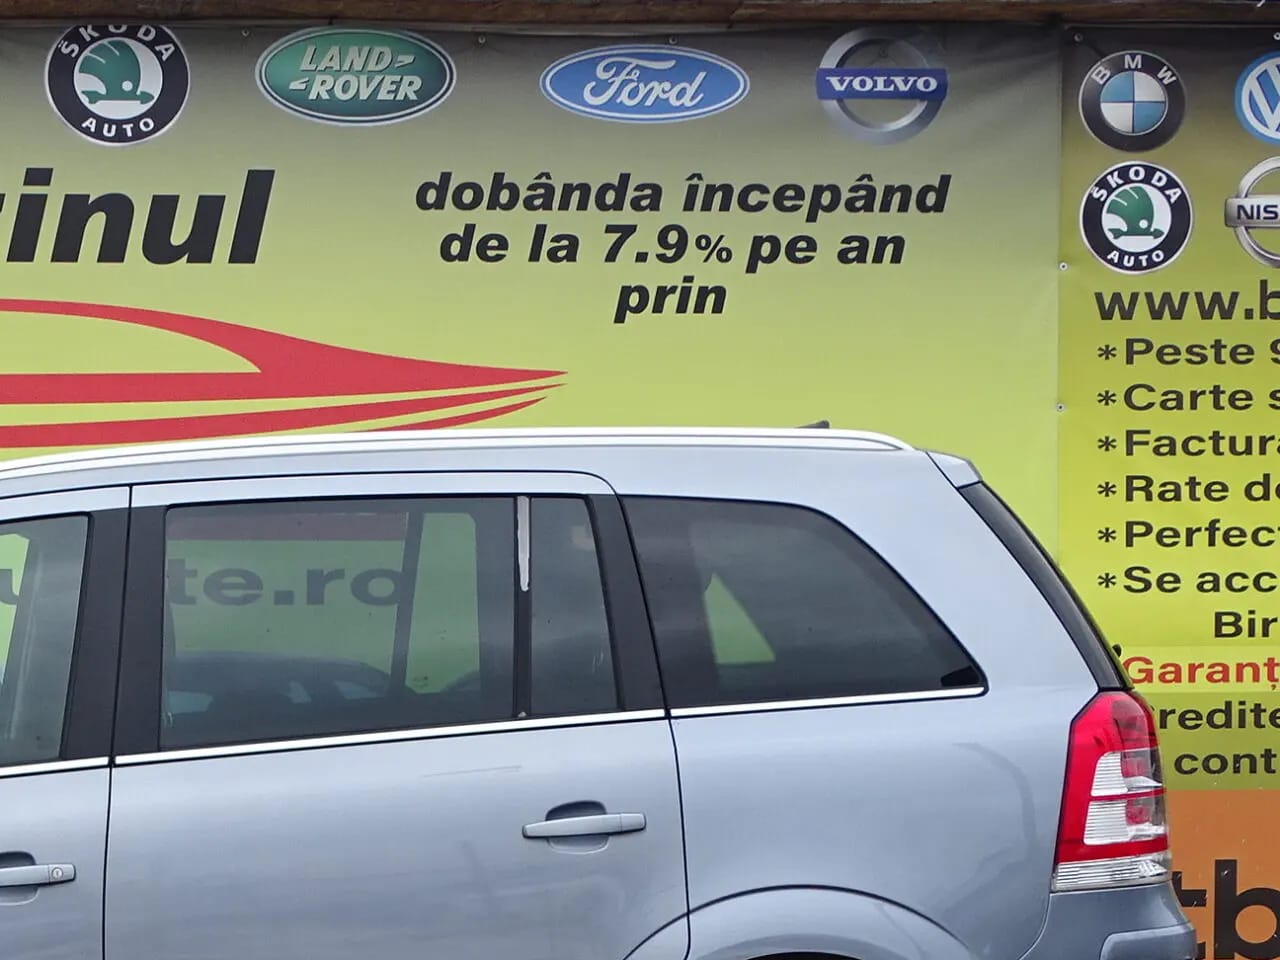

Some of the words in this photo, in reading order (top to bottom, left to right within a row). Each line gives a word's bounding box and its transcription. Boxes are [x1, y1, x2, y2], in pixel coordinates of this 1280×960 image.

[300, 45, 393, 72] LAND
[1092, 54, 1177, 86] BMW
[308, 75, 422, 101] ROVER
[583, 56, 707, 107] Ford
[825, 76, 938, 93] VOLVO
[82, 118, 155, 137] AUTO
[415, 171, 663, 213] dobânda
[682, 173, 951, 223] începând
[439, 223, 510, 263] de
[528, 223, 579, 263] la
[745, 229, 818, 274] pe
[837, 229, 907, 265] an
[1106, 250, 1165, 268] AUTO
[614, 276, 727, 324] prin
[1097, 429, 1280, 457] Factur
[1244, 473, 1280, 502] d
[1097, 518, 1280, 547] Perfec
[1152, 700, 1280, 730] redit
